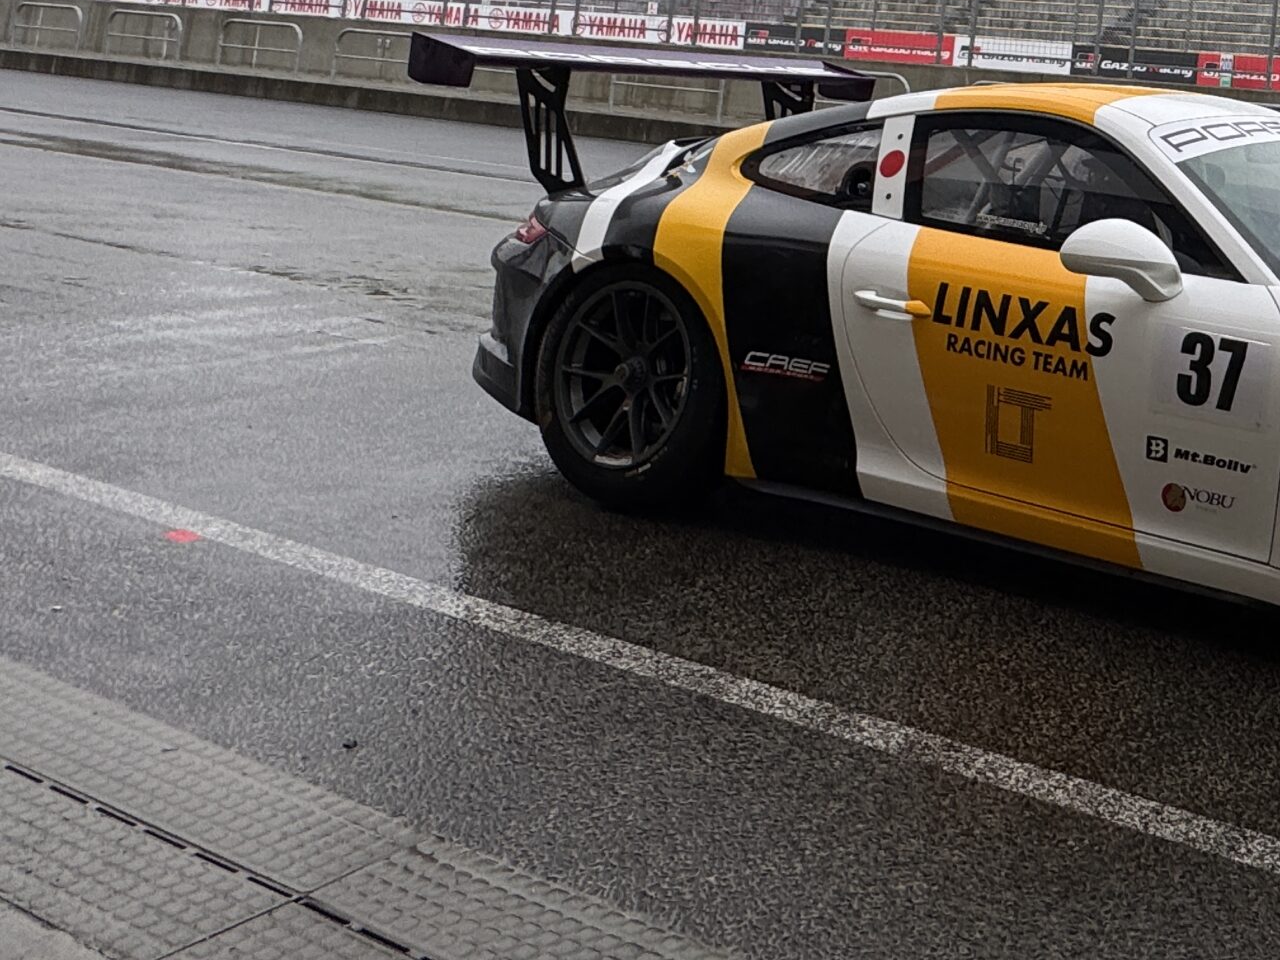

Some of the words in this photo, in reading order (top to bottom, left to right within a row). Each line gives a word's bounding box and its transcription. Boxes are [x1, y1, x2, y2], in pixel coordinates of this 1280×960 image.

[427, 4, 479, 25] YAMAA
[588, 15, 646, 39] YAMAHA
[677, 22, 738, 46] YAMAHA
[932, 282, 1116, 358] LINXAS
[946, 332, 1026, 367] RACING
[1032, 351, 1089, 382] TEAM
[1176, 331, 1249, 412] 37
[1182, 485, 1236, 509] NOBU
